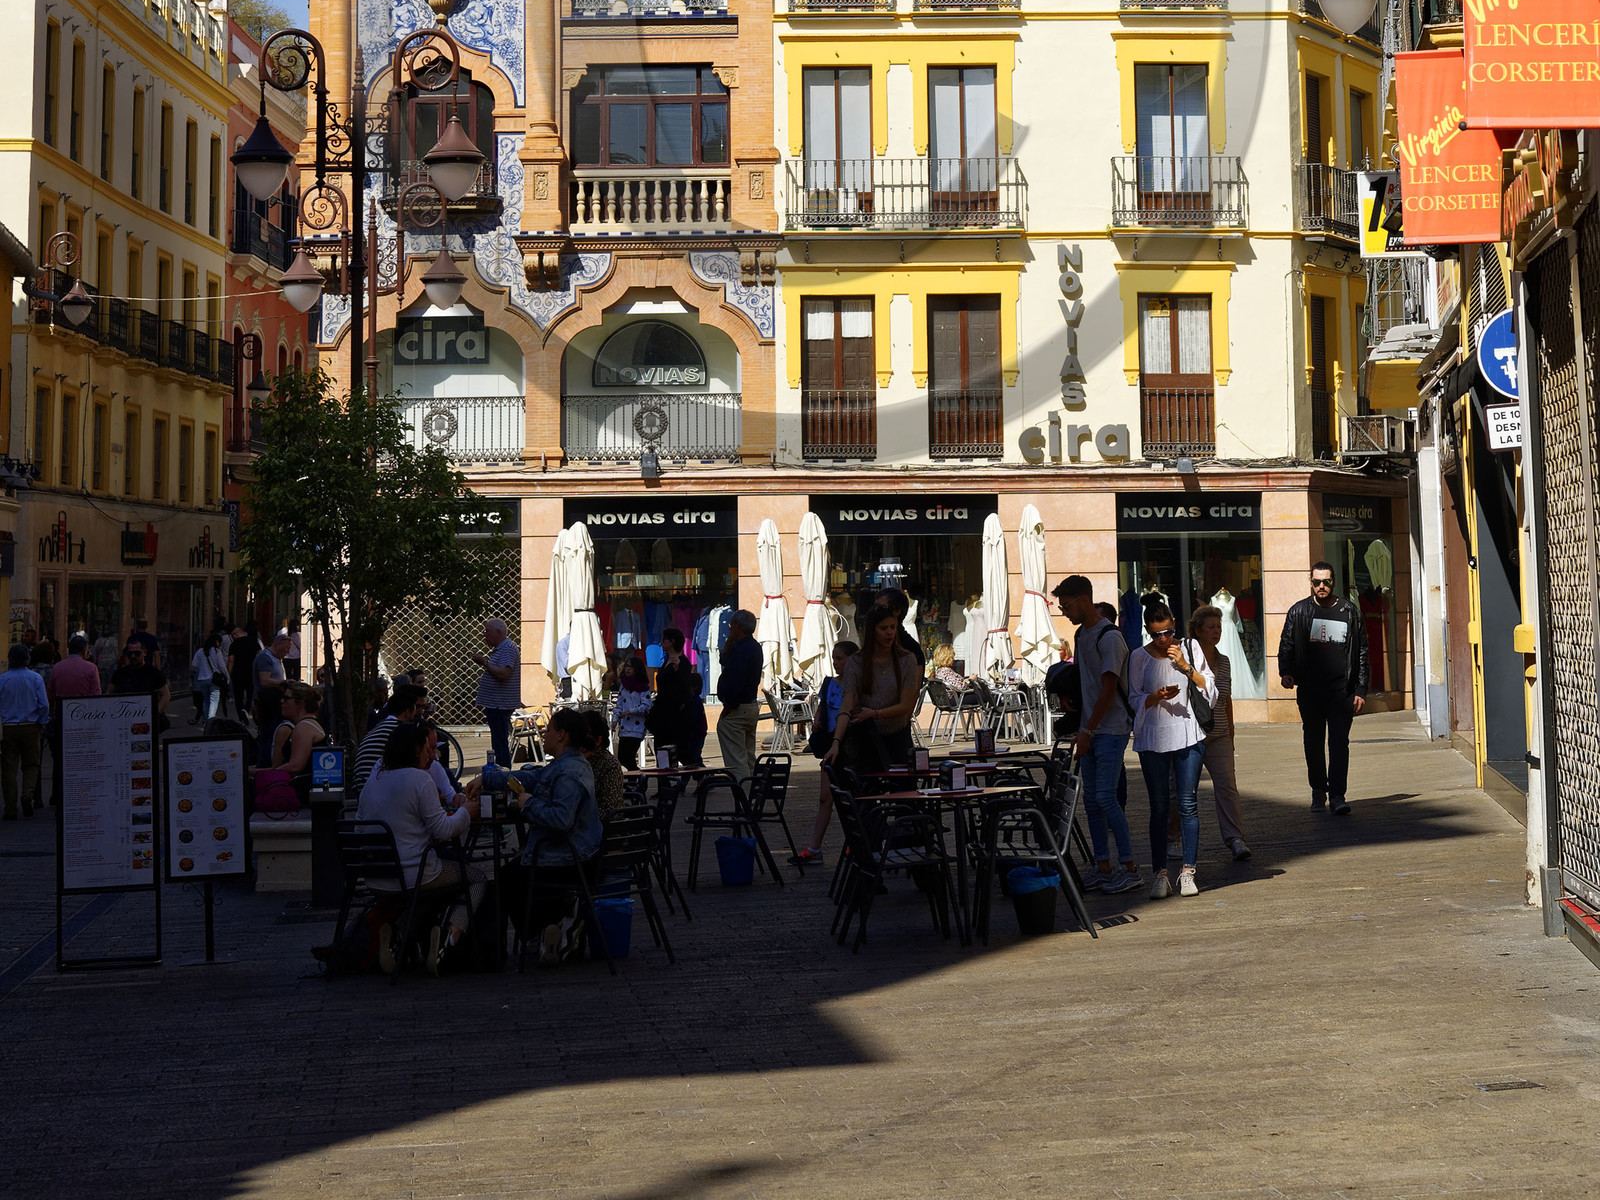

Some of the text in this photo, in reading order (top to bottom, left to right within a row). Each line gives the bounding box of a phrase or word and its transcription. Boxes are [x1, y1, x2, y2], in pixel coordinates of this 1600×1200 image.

[1399, 104, 1464, 167] Virginia
[1057, 244, 1086, 406] NOVIAS
[398, 320, 486, 360] cira
[601, 365, 700, 383] NOVIAS
[1493, 411, 1507, 420] DE
[1018, 411, 1129, 462] cira
[1500, 435, 1513, 444] LA
[587, 508, 716, 525] NOVIAS cira
[839, 505, 968, 521] NOVIAS cira
[1123, 502, 1252, 518] NOVIAS cira
[1329, 504, 1373, 519] NOVIAS cira
[67, 700, 148, 721] Casa Toni
